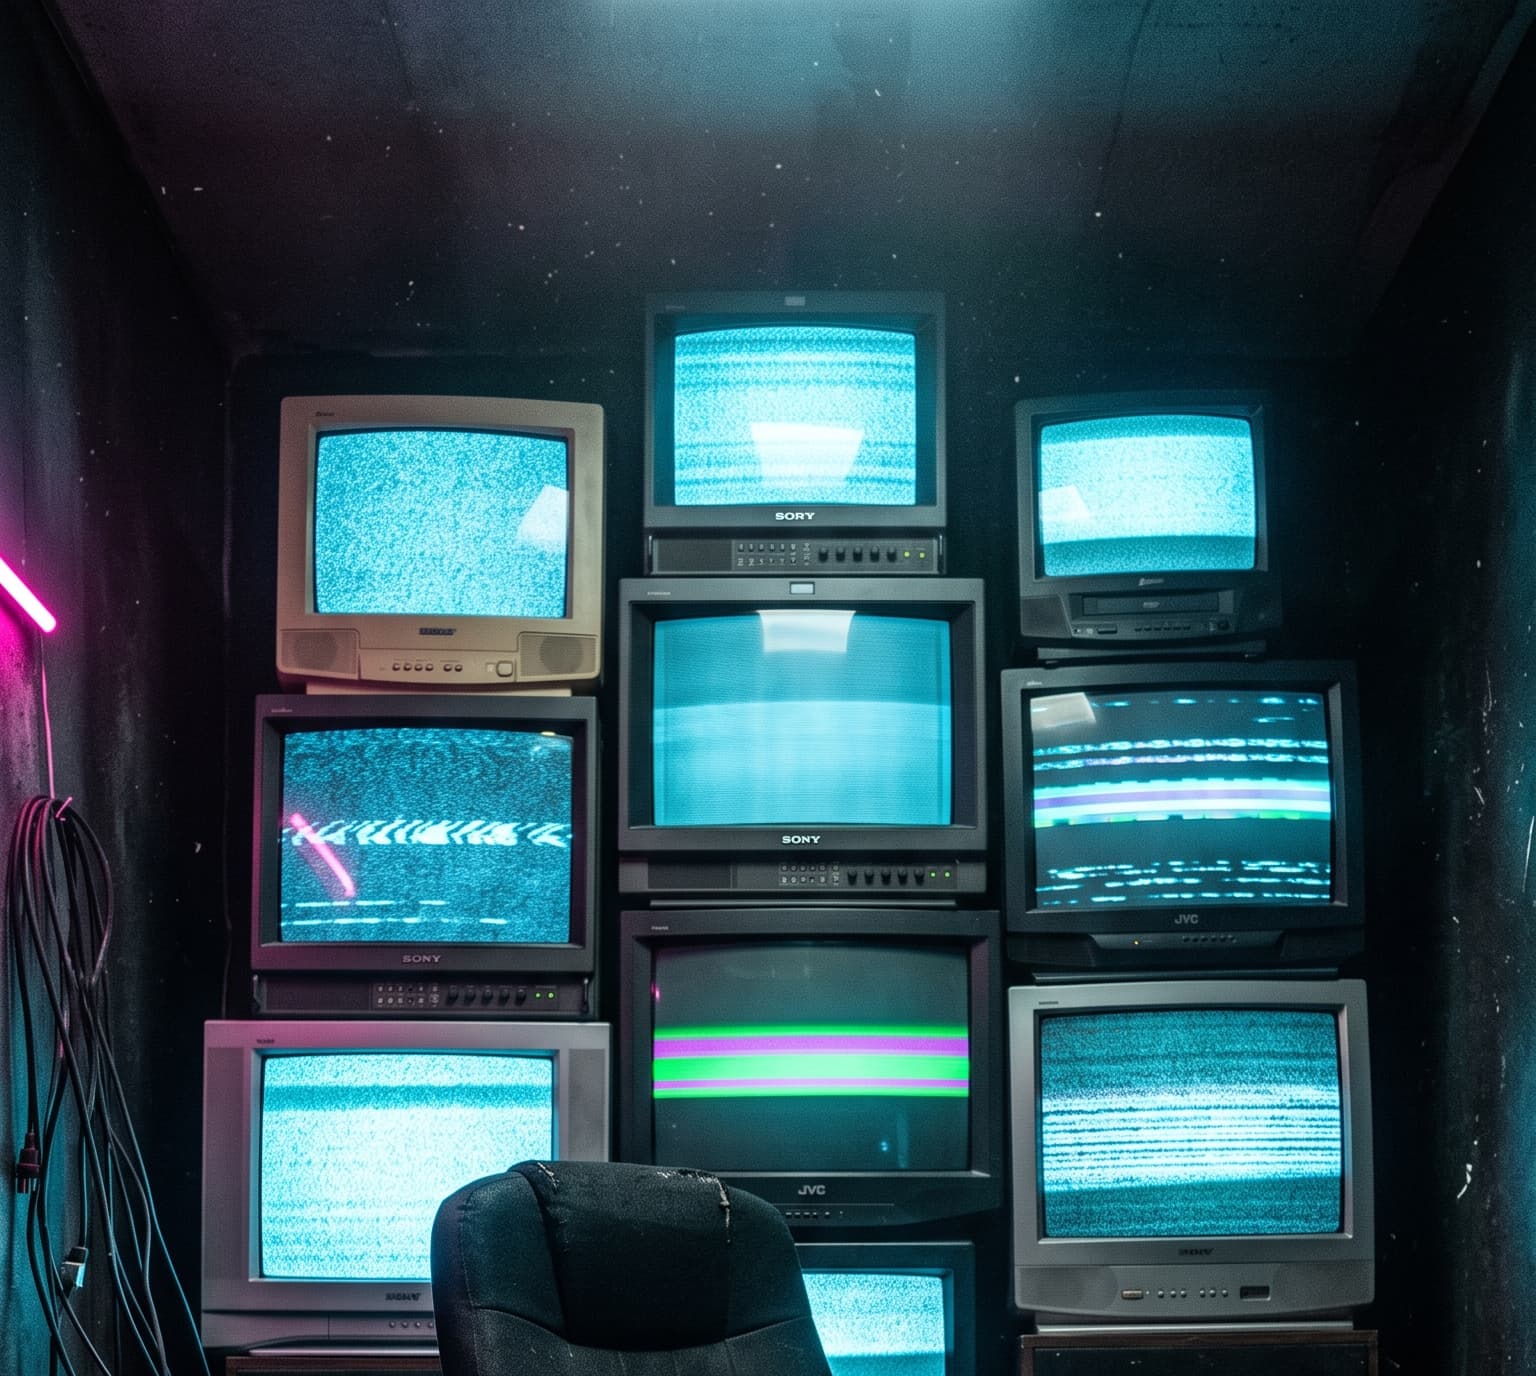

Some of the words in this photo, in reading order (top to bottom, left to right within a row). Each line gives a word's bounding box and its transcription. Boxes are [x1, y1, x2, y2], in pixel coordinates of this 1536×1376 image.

[782, 835, 821, 844] SONY
[1174, 913, 1199, 924] JVC
[402, 954, 441, 963] SONY
[797, 1184, 826, 1195] JVC
